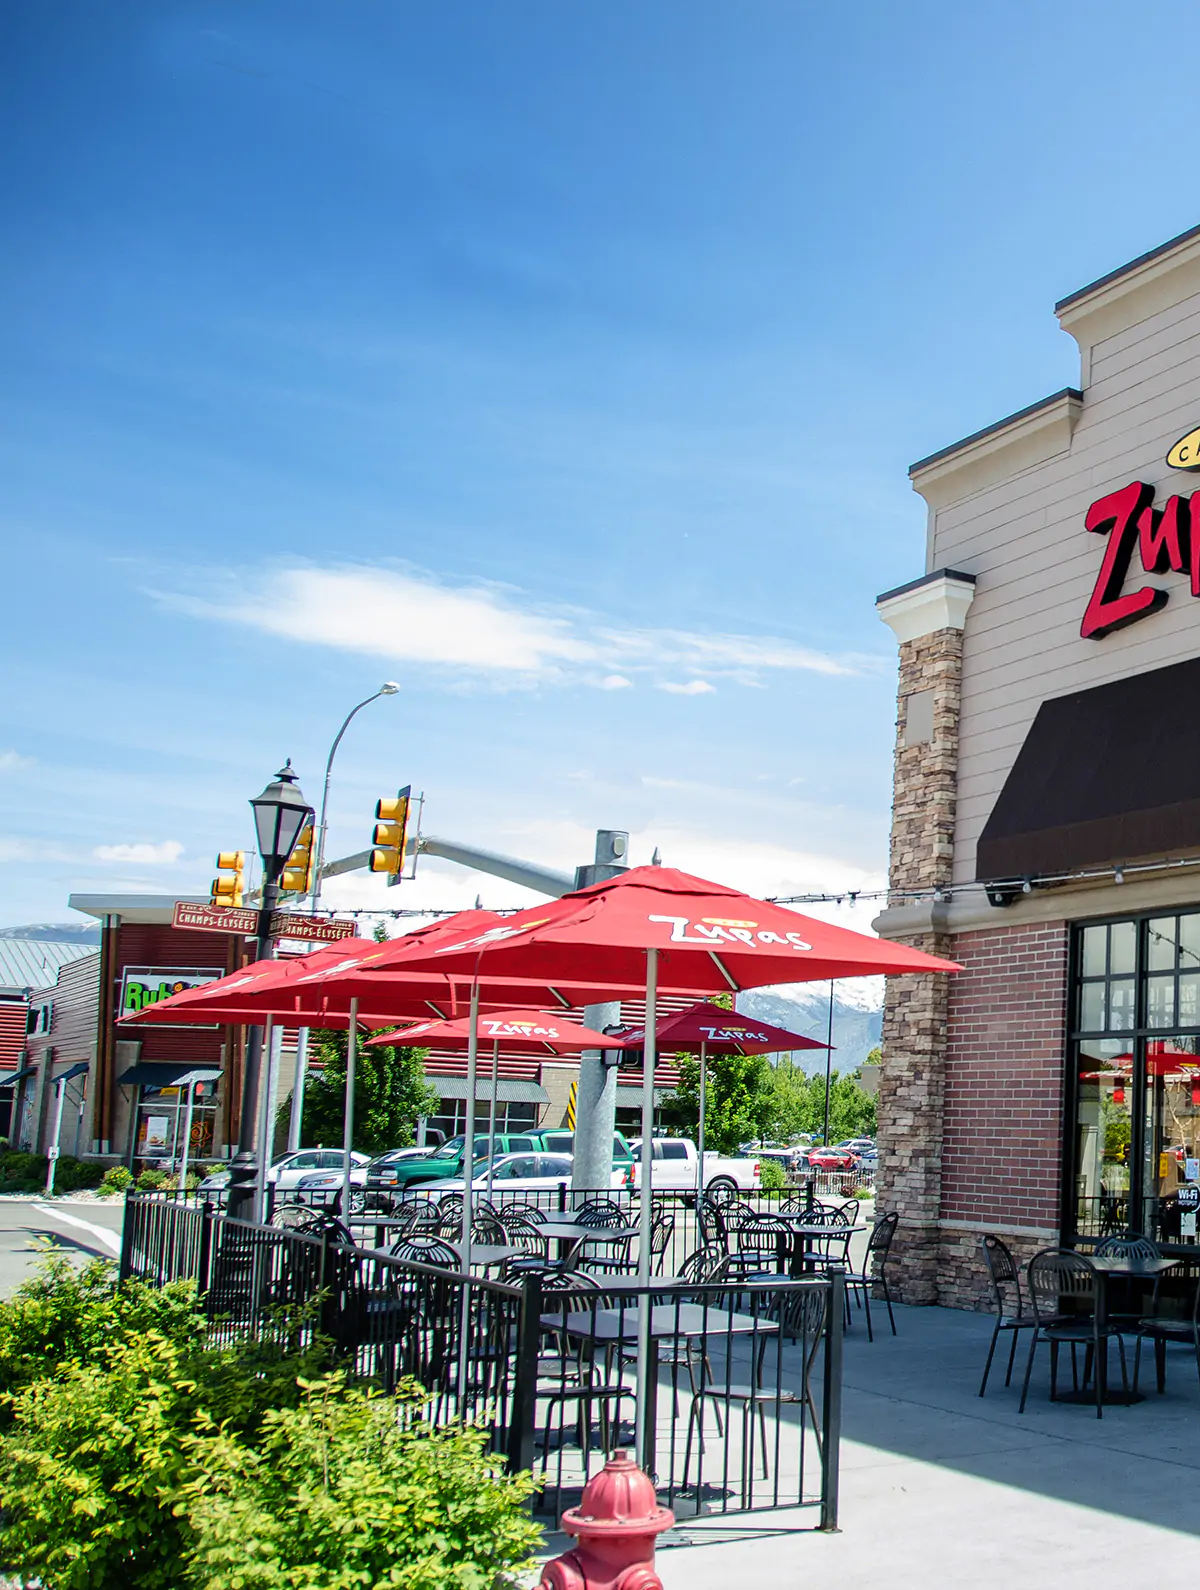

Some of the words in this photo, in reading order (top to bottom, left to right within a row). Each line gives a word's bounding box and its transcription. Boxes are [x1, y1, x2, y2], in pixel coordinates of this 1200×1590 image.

[179, 913, 255, 930] CHAMPS-ÉLYSÉES
[648, 914, 813, 951] Zupas
[482, 1020, 560, 1038] Zupas
[699, 1026, 768, 1042] Zupas
[1178, 1189, 1198, 1200] Wi-Fi
